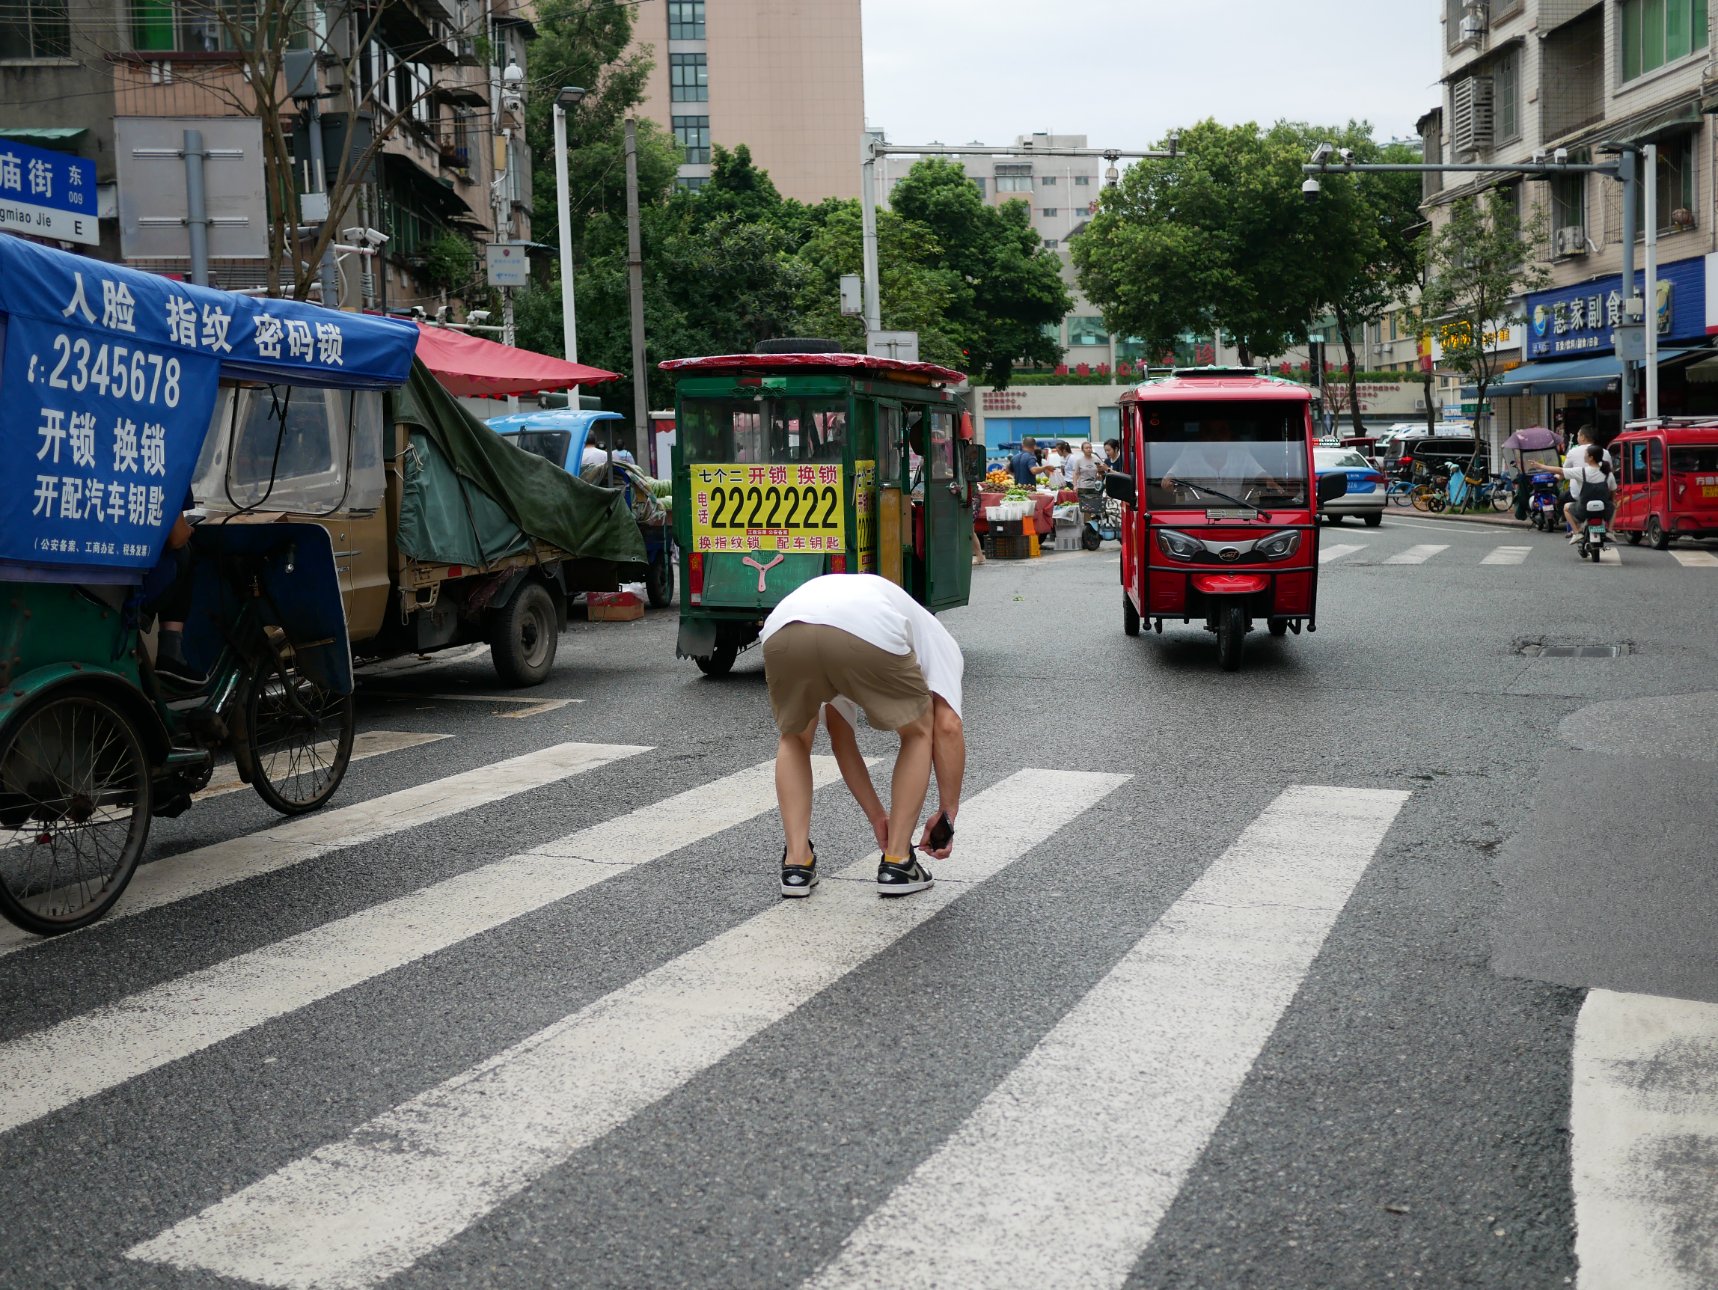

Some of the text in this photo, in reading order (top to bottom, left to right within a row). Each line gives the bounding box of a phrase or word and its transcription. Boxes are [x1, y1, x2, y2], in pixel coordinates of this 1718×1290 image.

[0, 152, 53, 198] 庙街
[68, 165, 82, 186] 东
[68, 191, 83, 205] 009
[37, 212, 51, 227] Jie
[74, 220, 82, 235] E
[63, 272, 343, 366] 人脸 指纹 密码锁
[1553, 287, 1642, 335] 惠家副食
[36, 408, 166, 477] 开锁 换锁
[699, 468, 743, 483] 七个二
[748, 466, 787, 485] 开锁
[797, 465, 838, 485] 换锁
[32, 474, 163, 526] 开配汽车钥匙
[697, 491, 709, 525] 电话
[710, 486, 838, 528] 2222222
[698, 536, 839, 550] 换指纹锁 配车钥匙
